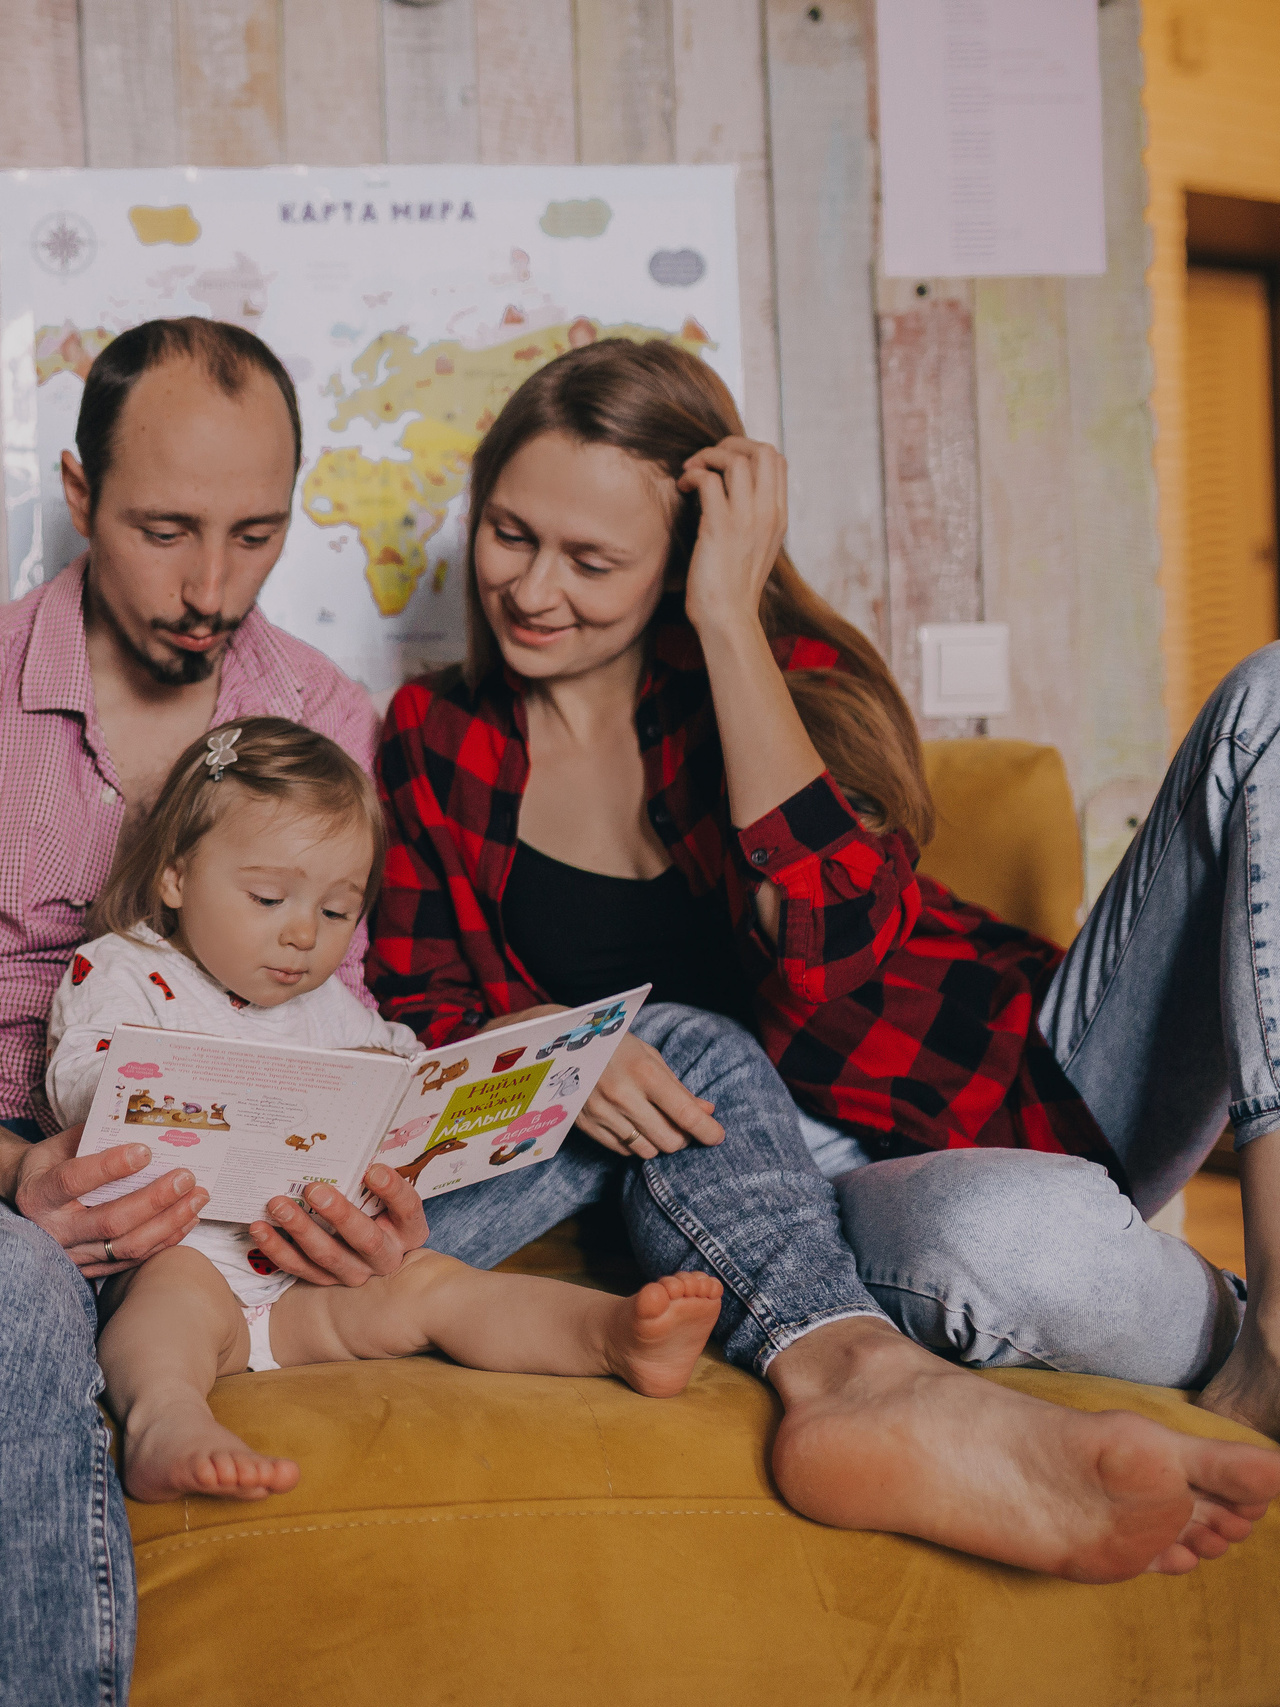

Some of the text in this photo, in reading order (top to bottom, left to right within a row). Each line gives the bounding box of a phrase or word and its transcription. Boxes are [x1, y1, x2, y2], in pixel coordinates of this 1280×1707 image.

[279, 200, 477, 223] КАРТА МИРА
[468, 1074, 531, 1099] Найди
[450, 1091, 526, 1120] покажи,
[302, 1175, 338, 1184] CLEVER
[432, 1178, 462, 1190] CLEVER
